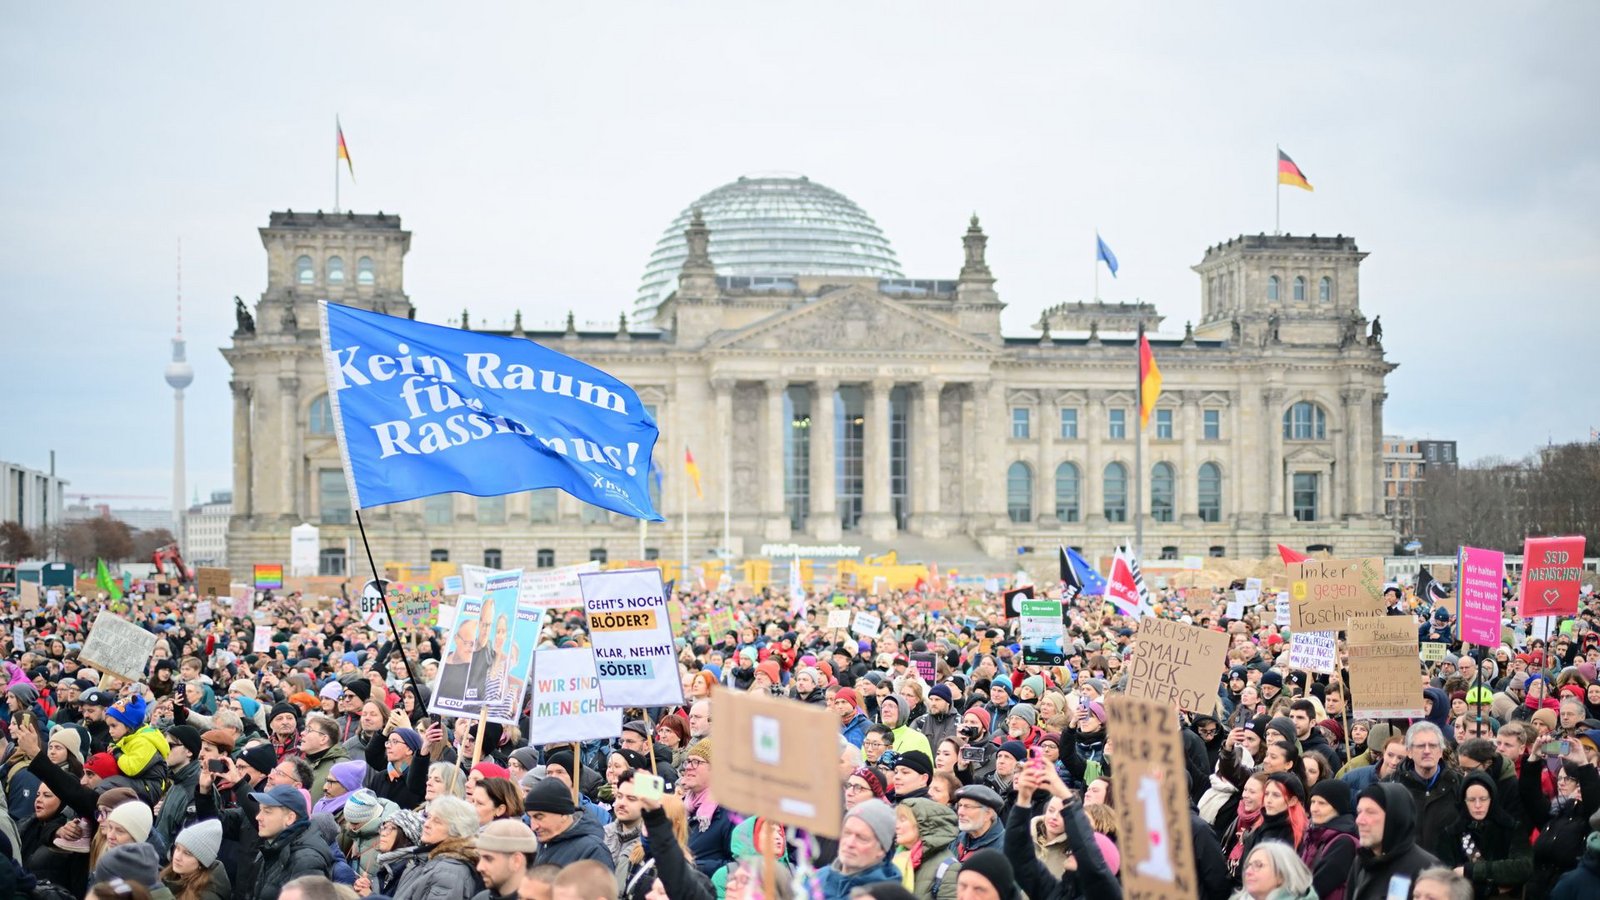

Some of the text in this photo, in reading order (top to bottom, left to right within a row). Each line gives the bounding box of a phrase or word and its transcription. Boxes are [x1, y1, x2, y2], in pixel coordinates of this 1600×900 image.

[331, 343, 629, 416] Kein Raum
[1543, 551, 1569, 564] SEID
[1300, 562, 1348, 579] Imker
[1466, 565, 1496, 576] Wir halten
[1529, 566, 1582, 582] MENSCHEN
[1466, 578, 1498, 588] zusammen.
[1314, 583, 1357, 601] gegen
[1484, 591, 1498, 600] Welt
[588, 596, 664, 610] GEHT'S NOCH
[1465, 600, 1497, 612] bleibt bunt.
[591, 612, 649, 628] BLÖDER?
[1143, 618, 1213, 656] RACISM IS
[1372, 628, 1410, 641] Barista
[595, 645, 671, 659] KLAR, NEHMT
[1137, 641, 1192, 666] SMALL
[600, 661, 647, 676] SÖDER!
[1133, 657, 1180, 685] DICK
[538, 677, 599, 693] WIR SIND
[538, 698, 618, 717] MENSCHE
